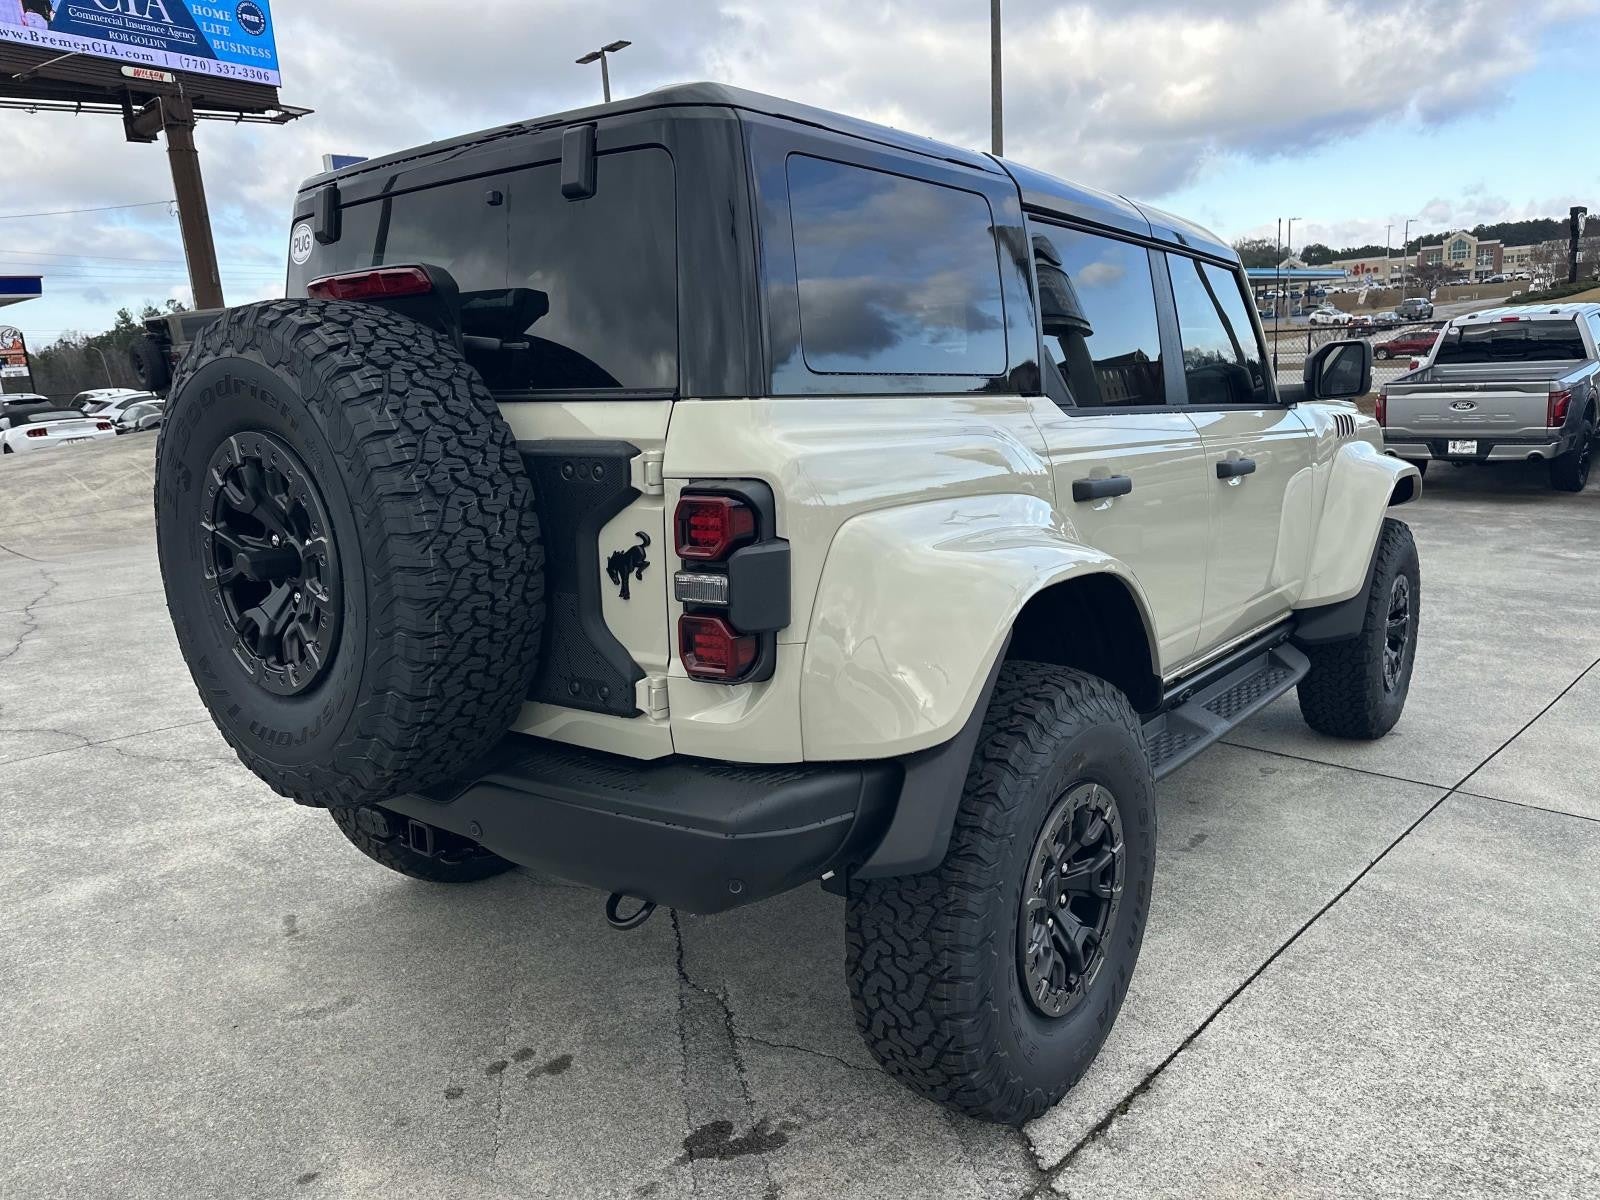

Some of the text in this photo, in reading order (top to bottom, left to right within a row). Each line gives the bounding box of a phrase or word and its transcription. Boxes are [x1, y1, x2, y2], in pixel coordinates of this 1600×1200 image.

[191, 4, 233, 22] HOME
[242, 13, 260, 23] FREE
[68, 7, 196, 43] Commercial Insurance Agency
[201, 21, 231, 37] LIFE
[108, 30, 167, 49] ROB GOLDIN
[212, 39, 272, 60] BUSINESS
[133, 68, 165, 81] WILSON
[179, 56, 211, 73] (770)
[216, 63, 271, 82] 537-3306
[294, 233, 310, 254] PUG
